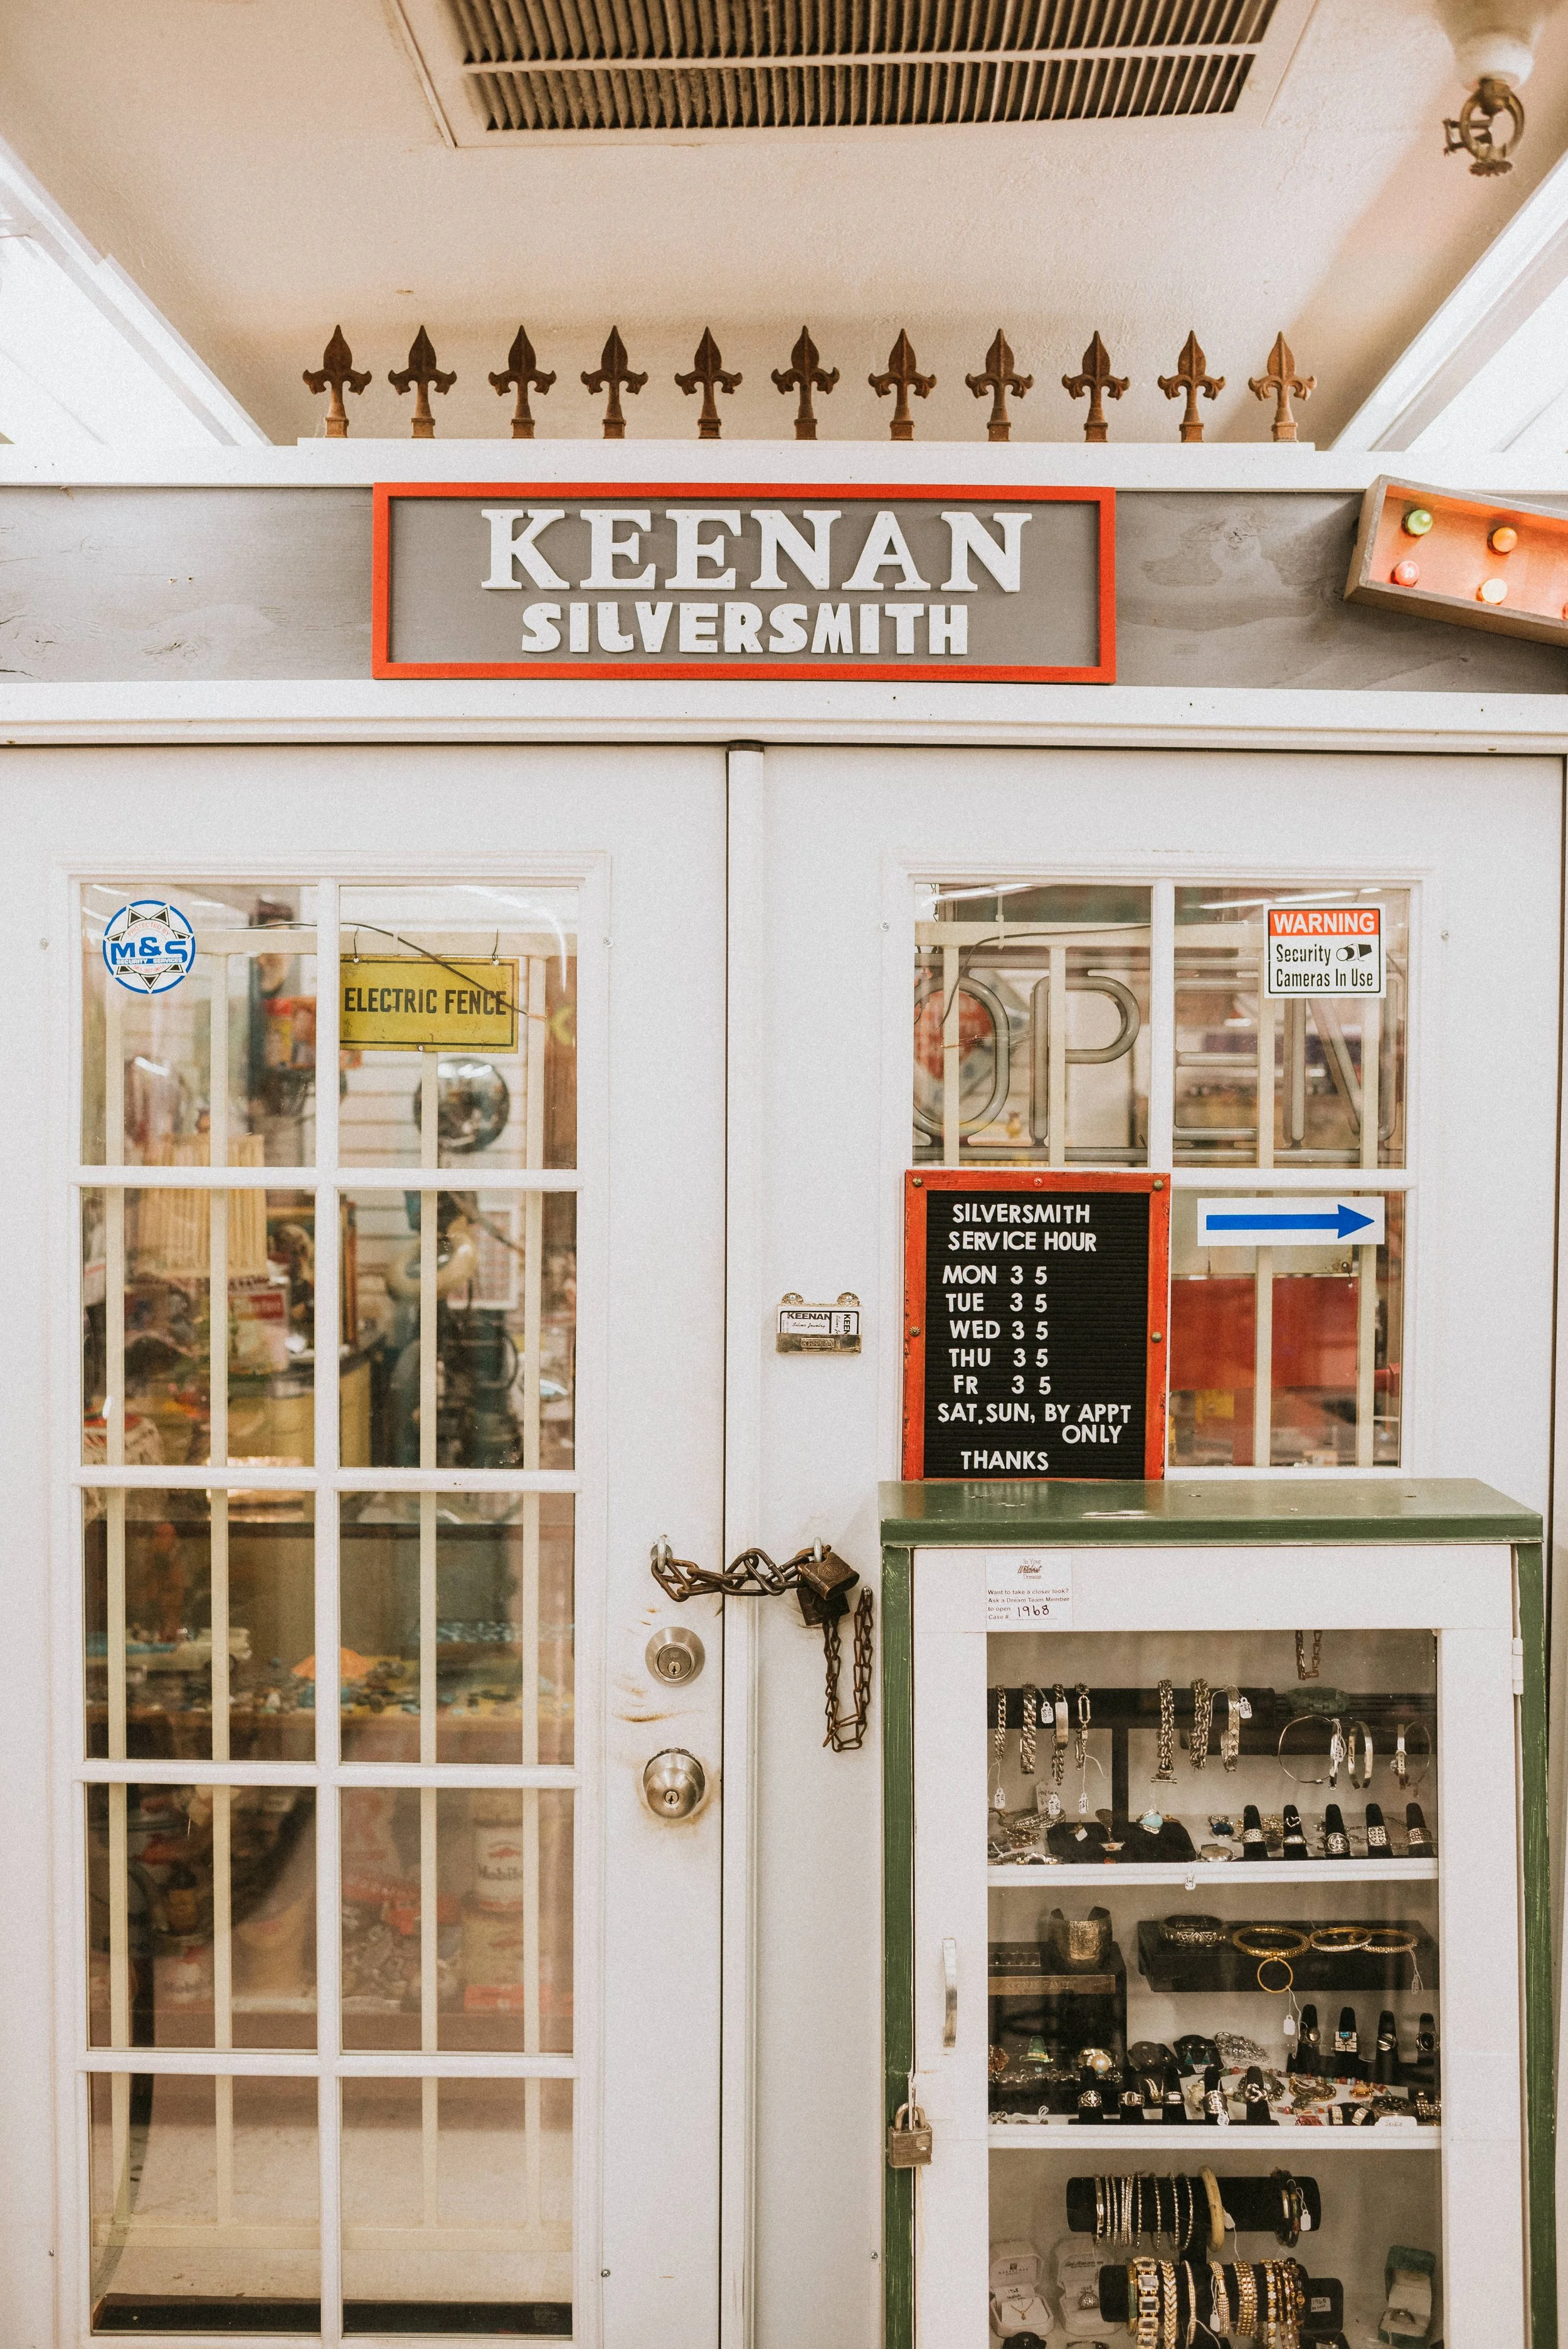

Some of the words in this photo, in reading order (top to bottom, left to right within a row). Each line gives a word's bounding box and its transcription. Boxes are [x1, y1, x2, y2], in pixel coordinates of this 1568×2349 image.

[481, 508, 1032, 593] KEENAN
[521, 600, 969, 656] SILVERSMITH
[127, 922, 162, 936] PROTECTED
[1273, 912, 1375, 933] WARNING
[110, 936, 188, 965] M&S
[1276, 943, 1331, 966] Security
[1276, 968, 1330, 987] Cameras
[1336, 968, 1347, 987] In
[1352, 968, 1373, 987] Use
[344, 987, 437, 1014] ELECTRIC
[445, 989, 507, 1015] FENCE
[952, 1203, 1090, 1224] SILVERSMITH
[948, 1231, 1036, 1251] SERVICE
[1044, 1231, 1096, 1251] HOUR
[942, 1265, 997, 1285] MON
[1010, 1265, 1024, 1285] 3
[1034, 1266, 1047, 1285] 5
[945, 1293, 984, 1312] TUE
[1010, 1293, 1023, 1312] 3
[1034, 1293, 1047, 1313] 5
[950, 1320, 1000, 1339] WED
[1012, 1320, 1025, 1340] 3
[1036, 1321, 1049, 1340] 5
[948, 1348, 992, 1367] THU
[1013, 1348, 1026, 1367] 3
[1036, 1349, 1049, 1368] 5
[953, 1375, 978, 1394] FR
[1011, 1376, 1024, 1394] 3
[1039, 1376, 1051, 1395] 5
[1045, 1404, 1071, 1423] BY
[1078, 1404, 1131, 1424] APPT
[1062, 1424, 1122, 1444] ONLY
[961, 1450, 1049, 1471] THANKS
[1017, 1564, 1042, 1574] Wildest
[1017, 1604, 1049, 1617] 1968
